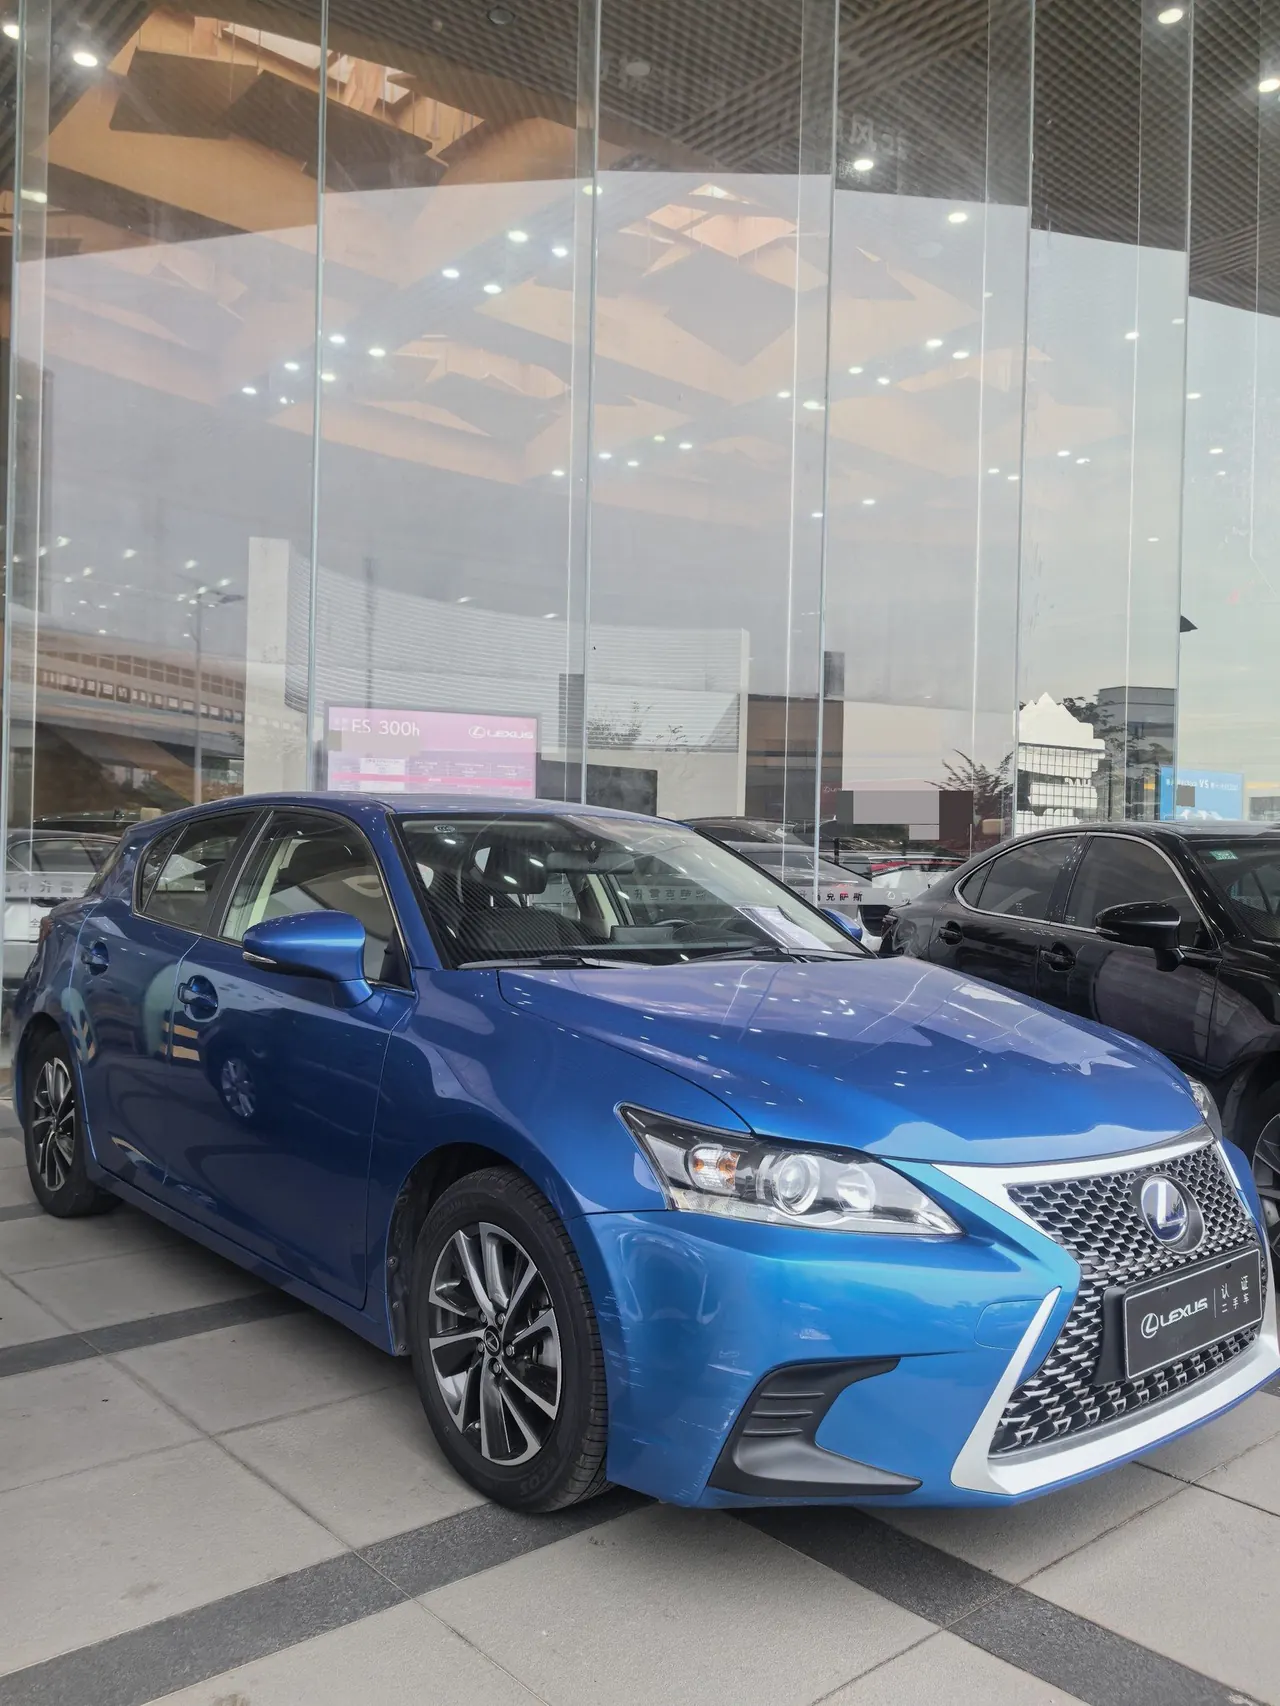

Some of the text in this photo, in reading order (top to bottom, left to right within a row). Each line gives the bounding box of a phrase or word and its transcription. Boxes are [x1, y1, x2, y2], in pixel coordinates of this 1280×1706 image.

[379, 720, 420, 736] 300h
[486, 729, 534, 739] LEXUS
[1160, 1298, 1208, 1327] LEXUS
